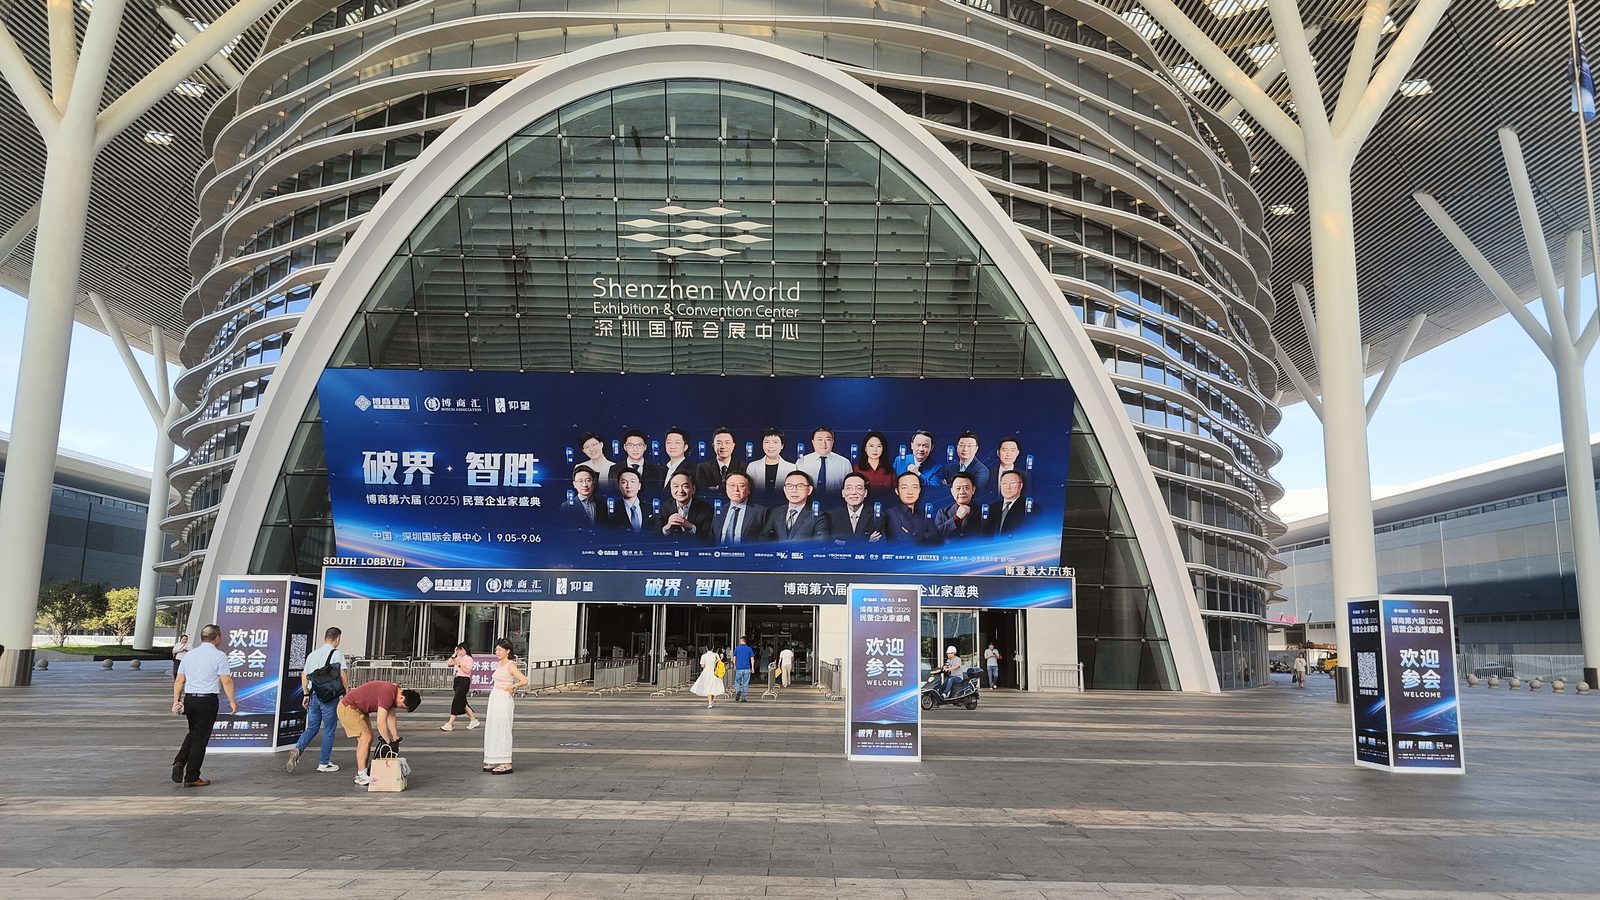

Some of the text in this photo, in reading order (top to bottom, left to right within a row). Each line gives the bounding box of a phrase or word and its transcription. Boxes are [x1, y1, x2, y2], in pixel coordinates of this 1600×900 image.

[592, 277, 800, 301] Shenzhen World
[593, 302, 800, 318] Exhibition & Convention Center
[594, 320, 799, 340] 深圳国际会展中心
[362, 451, 436, 486] 破界
[465, 452, 542, 488] 智胜
[322, 556, 405, 567] SOUTH LOBBY(E)
[1005, 565, 1076, 577] 南登录大厅(东)
[228, 628, 269, 648] 欢迎
[865, 637, 904, 656] 欢迎
[227, 649, 267, 669] 参会
[865, 657, 904, 678] 参会
[1399, 648, 1440, 669] 欢迎
[1401, 669, 1441, 689] 参会
